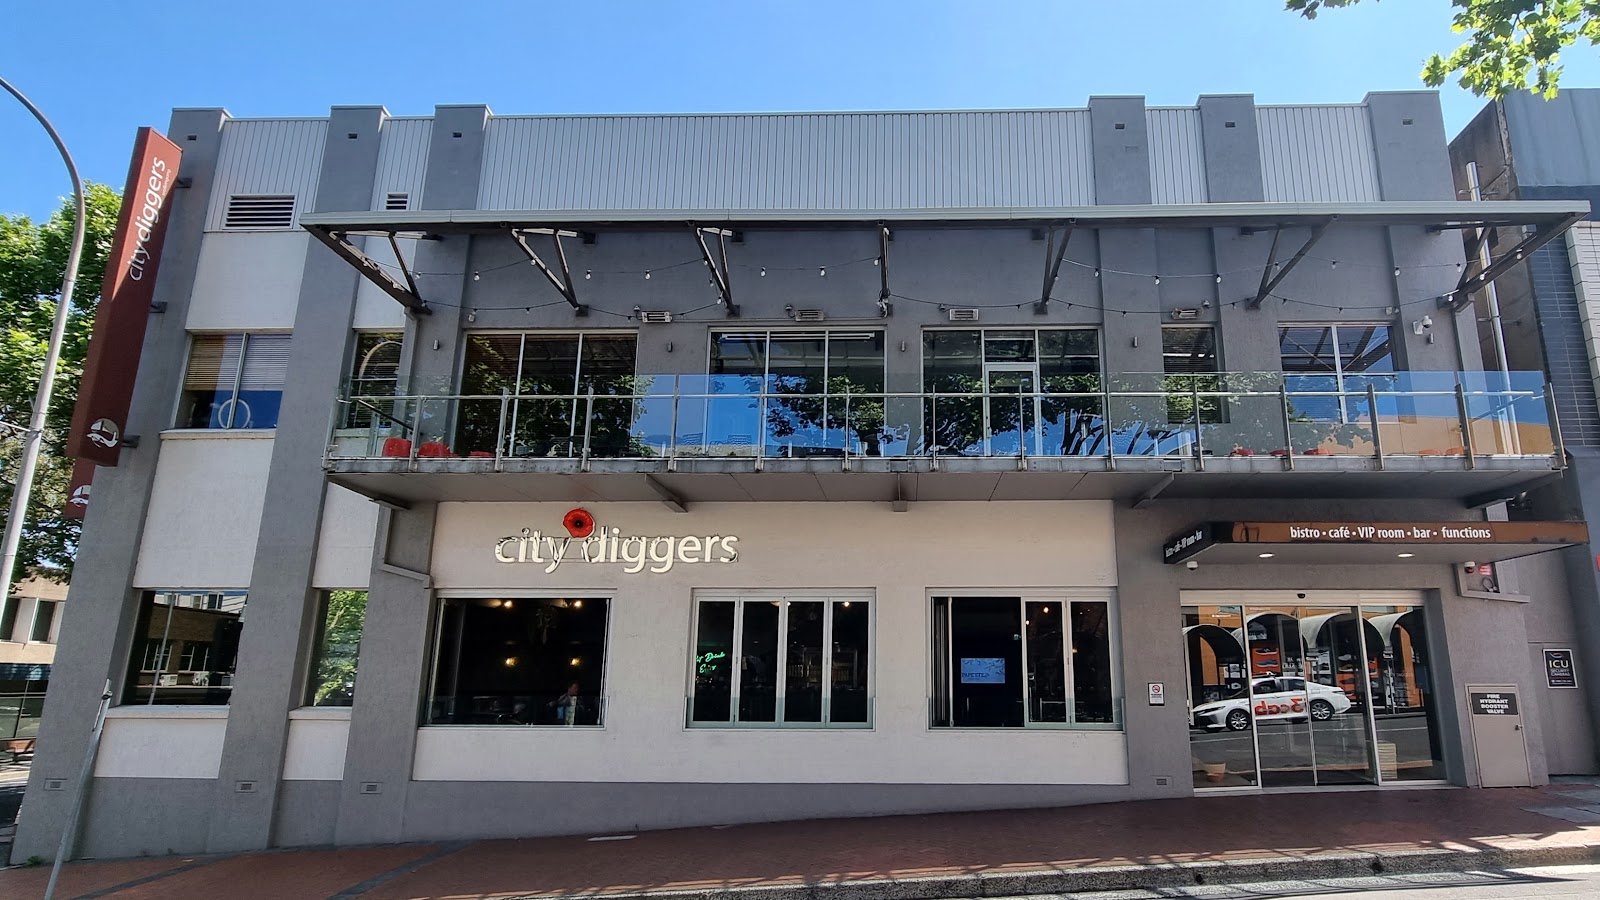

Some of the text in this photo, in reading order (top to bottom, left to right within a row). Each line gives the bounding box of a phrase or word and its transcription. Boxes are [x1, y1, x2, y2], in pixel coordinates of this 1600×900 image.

[1290, 526, 1491, 539] bistro café VIP room bar functions
[494, 525, 739, 574] city diggers
[1549, 660, 1569, 668] ICU
